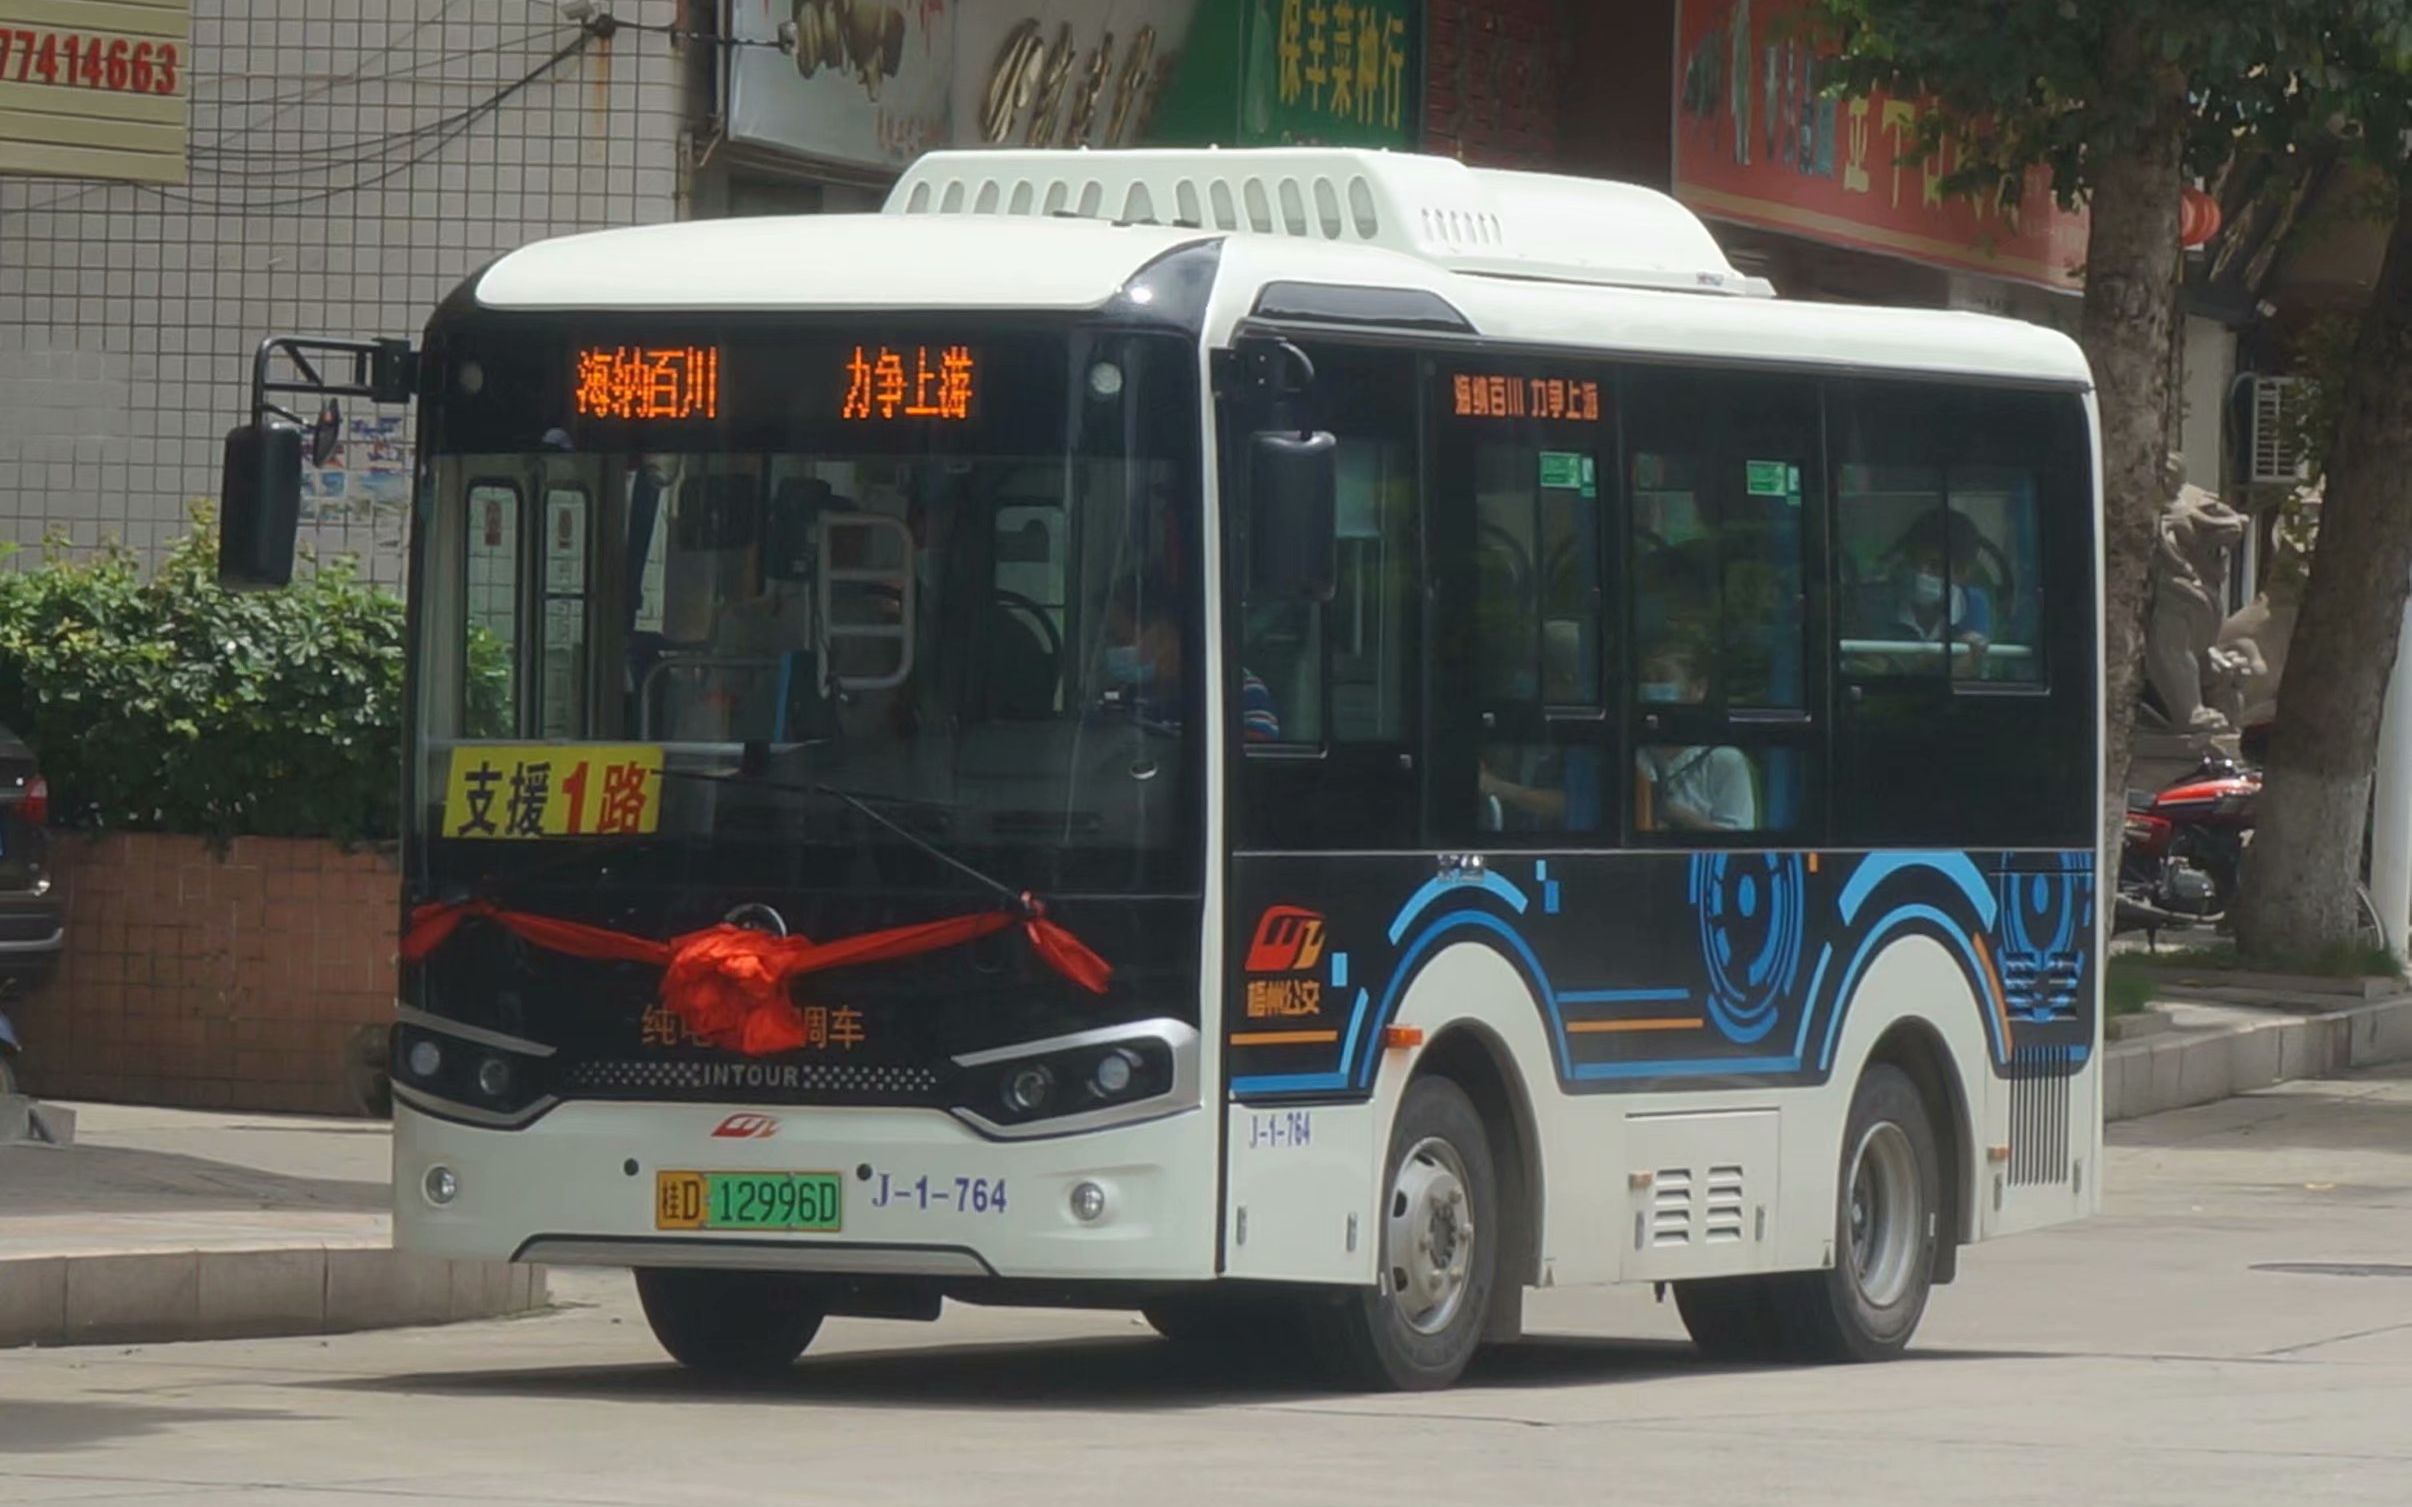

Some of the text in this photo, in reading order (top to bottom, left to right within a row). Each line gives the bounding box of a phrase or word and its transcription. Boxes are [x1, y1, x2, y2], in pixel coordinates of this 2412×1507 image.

[0, 28, 177, 95] 77414663
[576, 346, 974, 418] 海纳百川 力争上游
[457, 760, 648, 835] 支援1路
[704, 1065, 799, 1087] INTOUR
[1250, 1112, 1311, 1148] J-1-764
[662, 1180, 837, 1222] 桂D 12996D
[872, 1173, 1007, 1213] J-1-764
